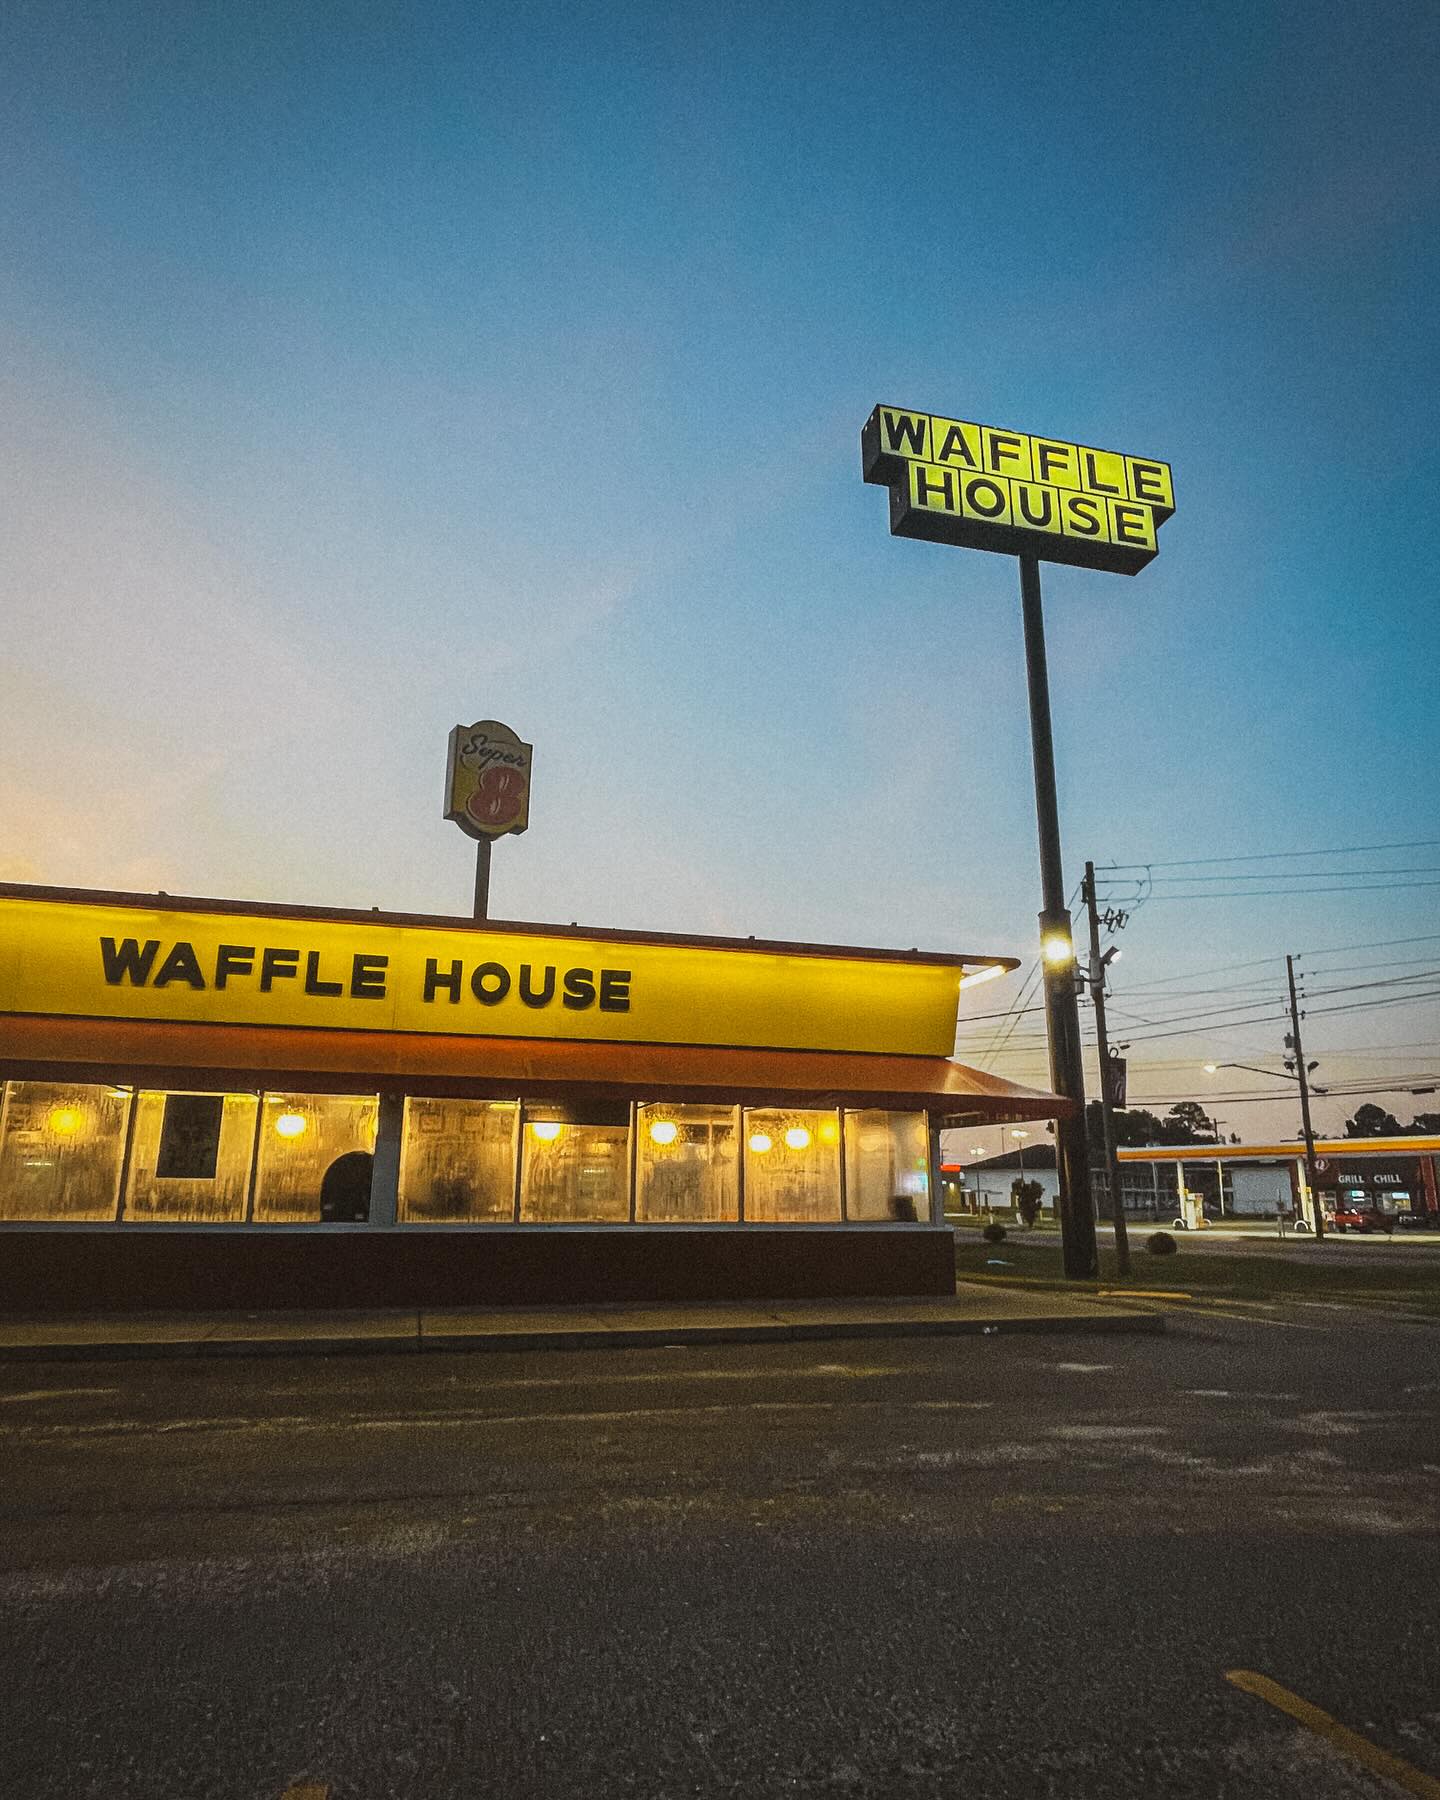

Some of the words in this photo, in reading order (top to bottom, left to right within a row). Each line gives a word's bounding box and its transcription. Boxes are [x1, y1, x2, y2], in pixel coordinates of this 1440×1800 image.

[884, 411, 1165, 502] WAFFLE
[917, 466, 1147, 545] HOUSE
[461, 733, 527, 769] Super
[466, 766, 525, 826] 8
[100, 937, 388, 998] WAFFLE
[424, 958, 632, 1011] HOUSE
[1338, 1175, 1365, 1183] GRILL
[1373, 1174, 1402, 1183] CHILL
